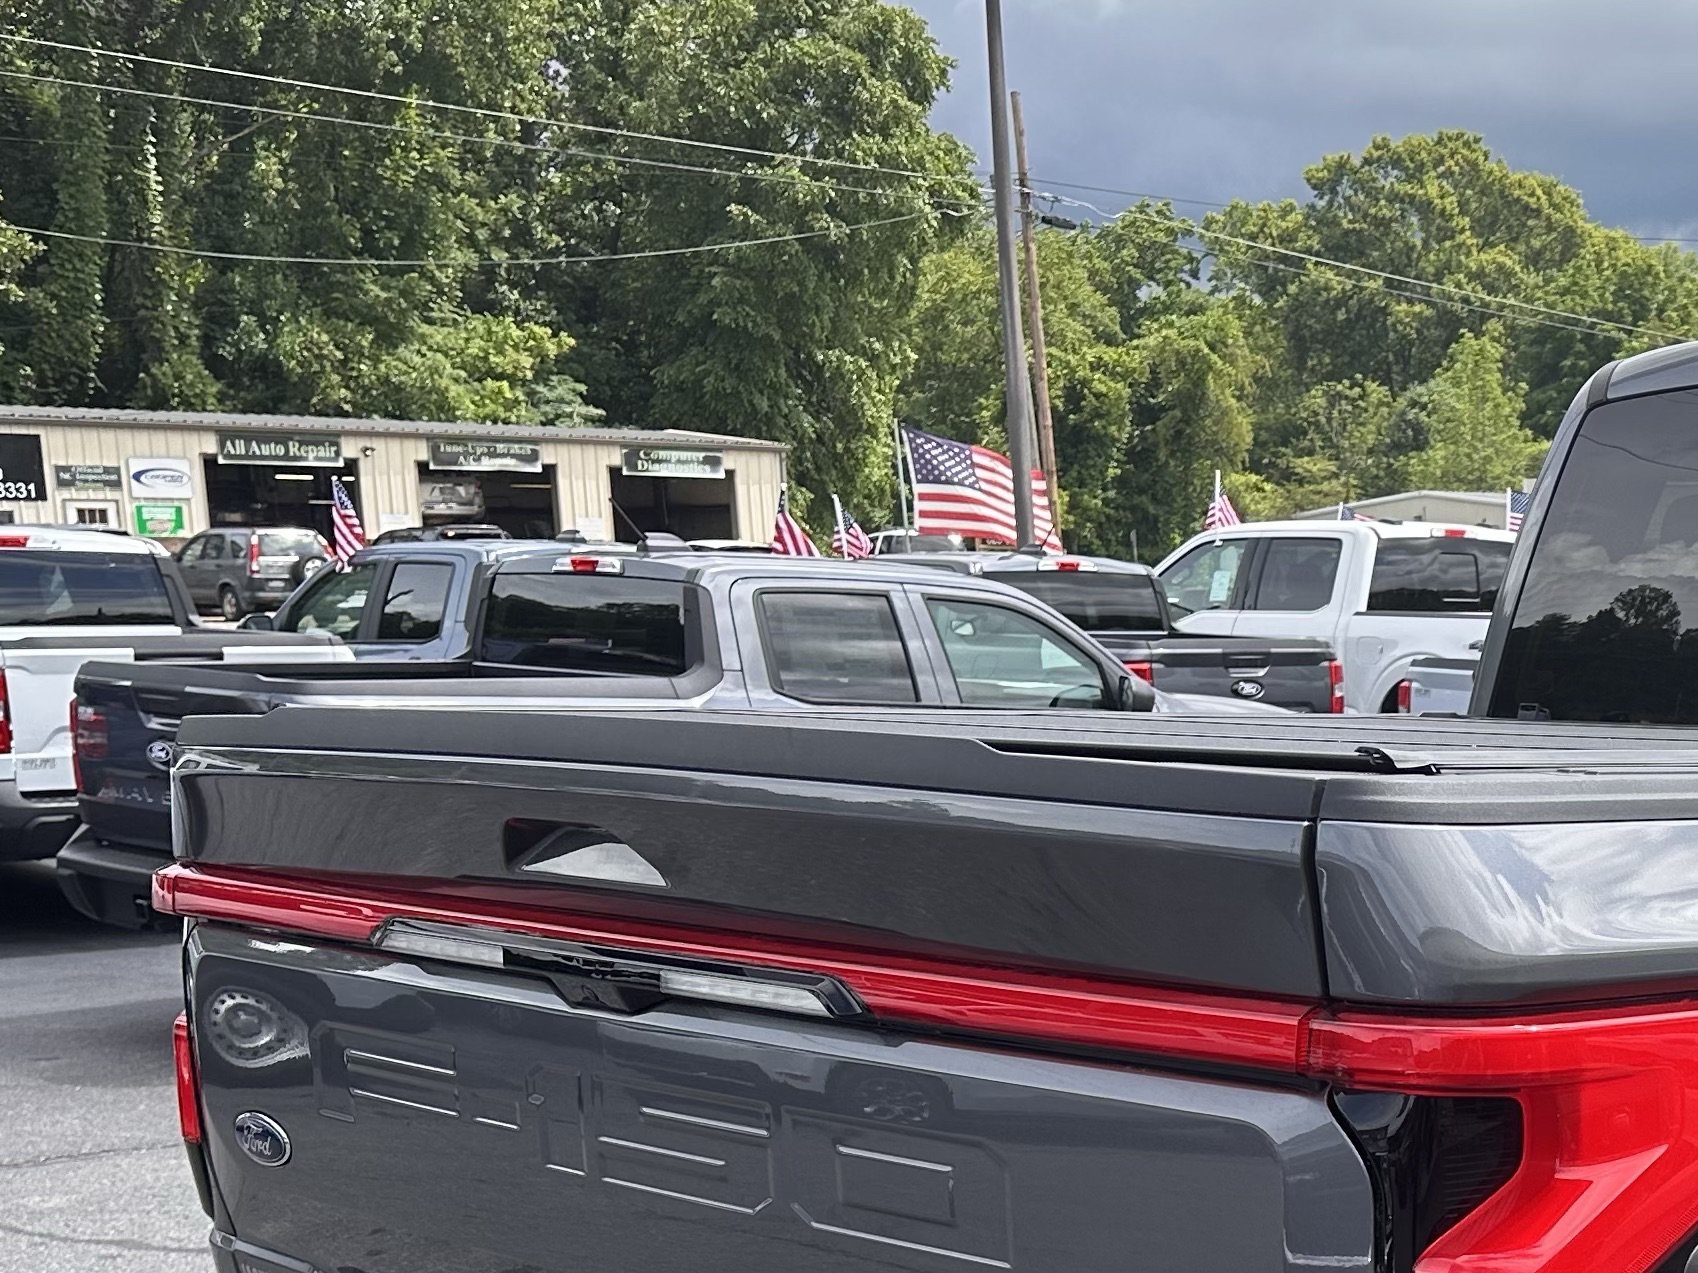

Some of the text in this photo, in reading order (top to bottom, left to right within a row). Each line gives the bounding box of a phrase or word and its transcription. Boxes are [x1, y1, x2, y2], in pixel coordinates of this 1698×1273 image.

[223, 439, 337, 461] All Auto Repair
[639, 450, 704, 462] Computer
[637, 460, 711, 473] Diagnostics
[312, 1021, 1012, 1270] F-150
